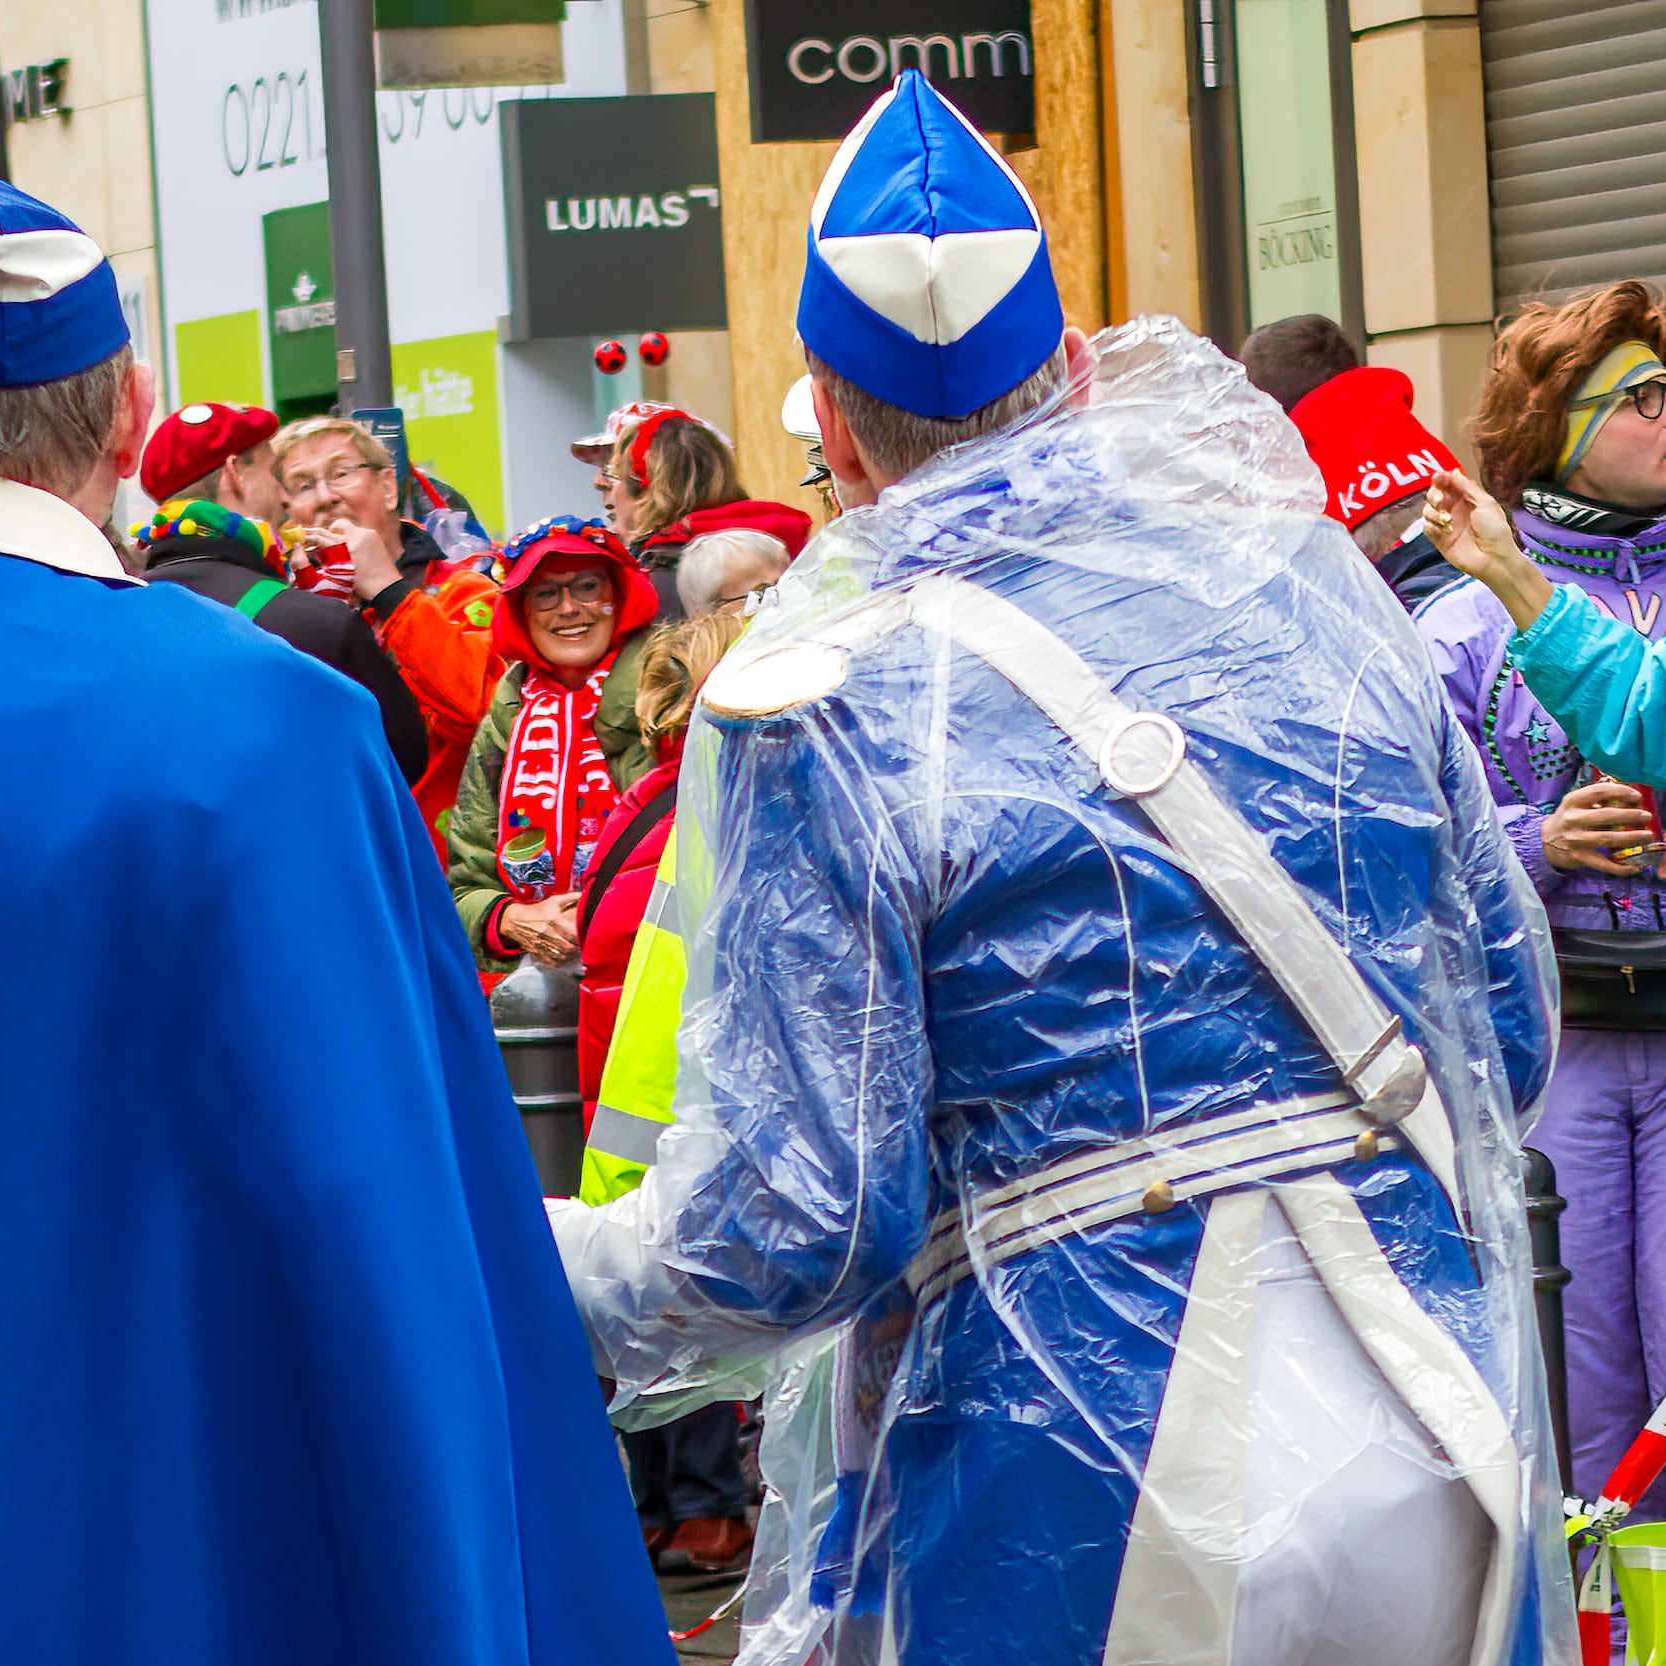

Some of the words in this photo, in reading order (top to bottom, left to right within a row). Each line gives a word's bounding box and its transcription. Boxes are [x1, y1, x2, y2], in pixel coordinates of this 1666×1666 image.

[787, 32, 1032, 84] comm
[546, 193, 689, 231] LUMAS
[1337, 448, 1445, 519] KÖLN
